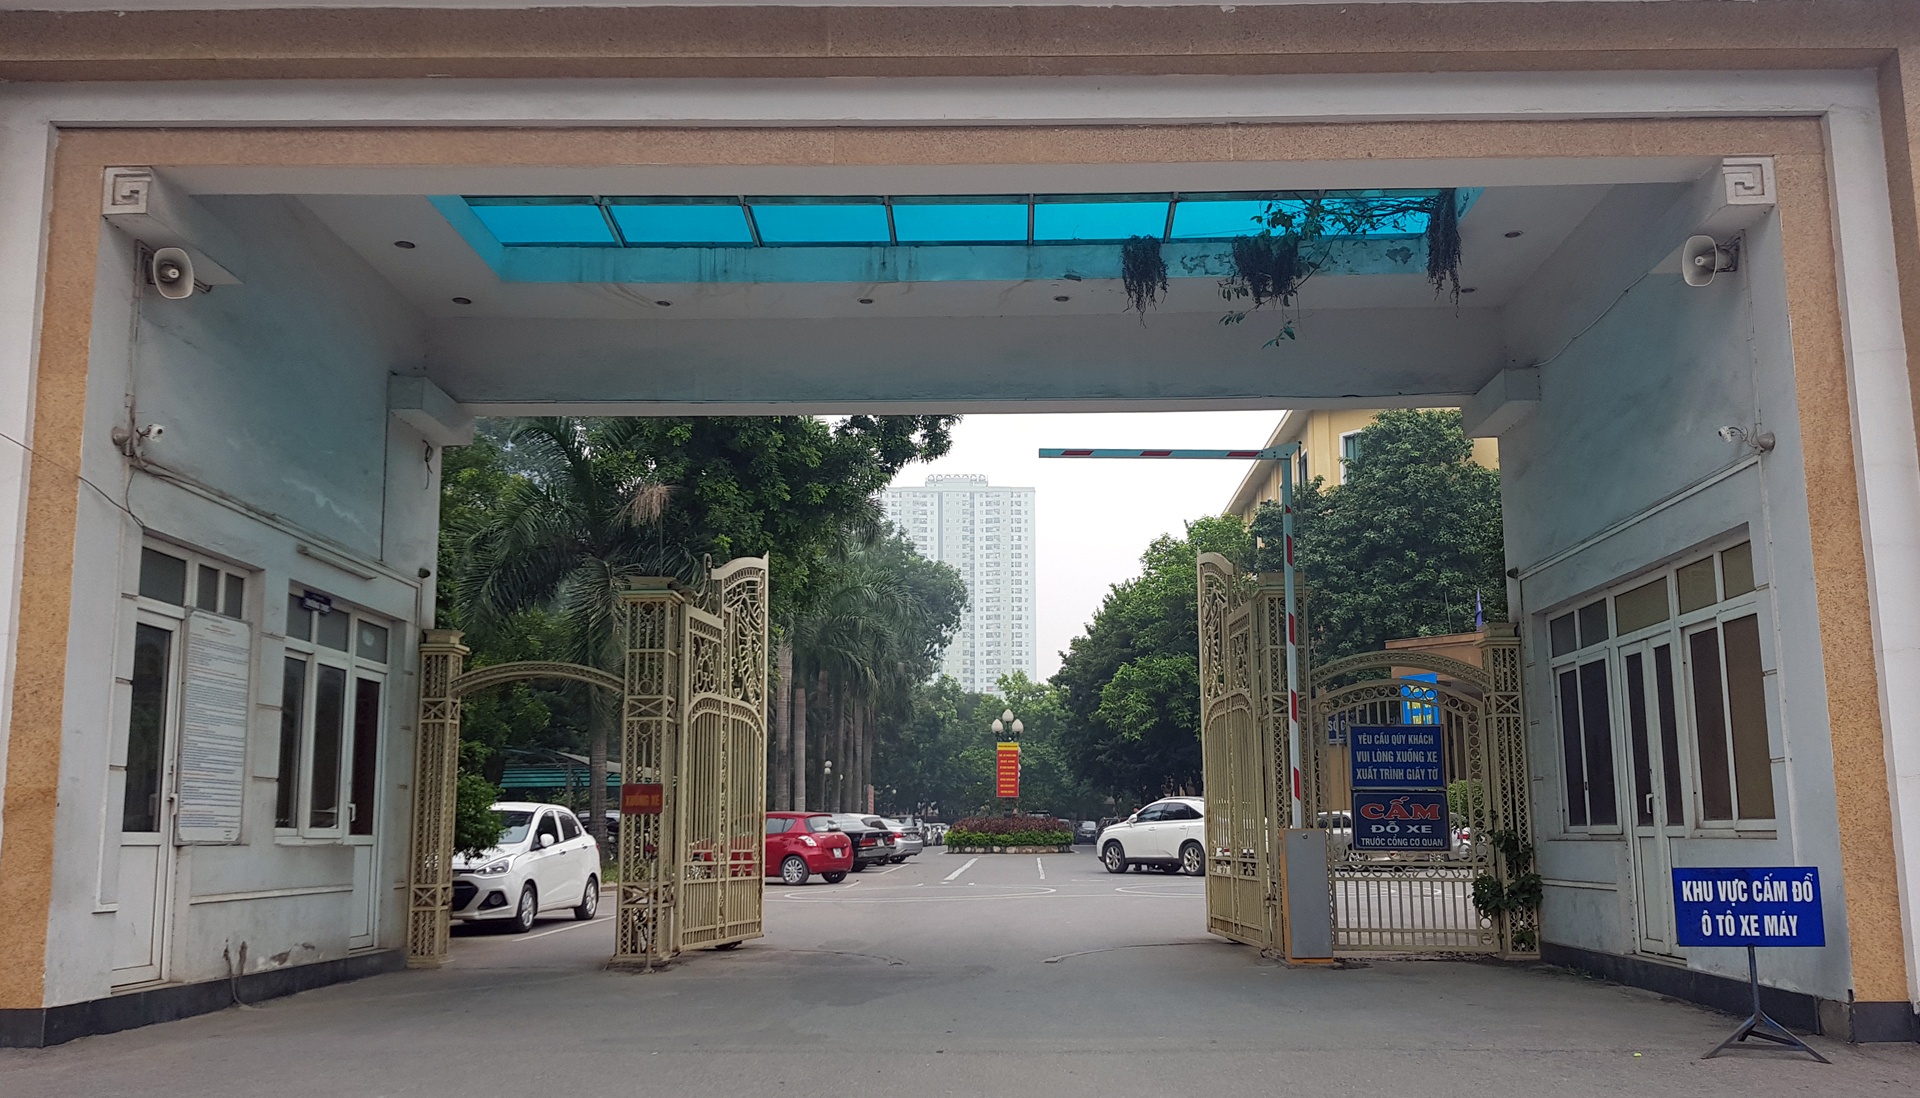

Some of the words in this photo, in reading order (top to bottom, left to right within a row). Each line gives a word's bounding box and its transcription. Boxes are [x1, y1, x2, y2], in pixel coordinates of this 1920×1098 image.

[1358, 733, 1372, 744] YÊU
[1408, 732, 1433, 744] KHÁCH
[1356, 751, 1370, 762] VUI
[1372, 748, 1394, 762] LÒNG
[1396, 748, 1424, 762] XUỐNG
[1427, 751, 1437, 762] XE
[1356, 766, 1378, 780] XUẤT
[1380, 766, 1404, 780] TRÌNH
[1406, 766, 1426, 780] GIẤY
[1360, 796, 1440, 820] CẤM
[1370, 820, 1400, 833] ĐỖ
[1406, 824, 1432, 833] XE
[1360, 835, 1386, 846] TRƯỚC
[1387, 834, 1408, 846] CỔNG
[1421, 838, 1443, 846] QUAN
[1682, 880, 1713, 902] KHU
[1717, 878, 1748, 907] VỰC
[1752, 873, 1788, 902] CẤM
[1792, 872, 1814, 902] ĐỖ
[1701, 909, 1713, 936] Ô
[1716, 909, 1736, 936] TÔ
[1739, 914, 1760, 937] XE
[1764, 910, 1798, 937] MÁY
